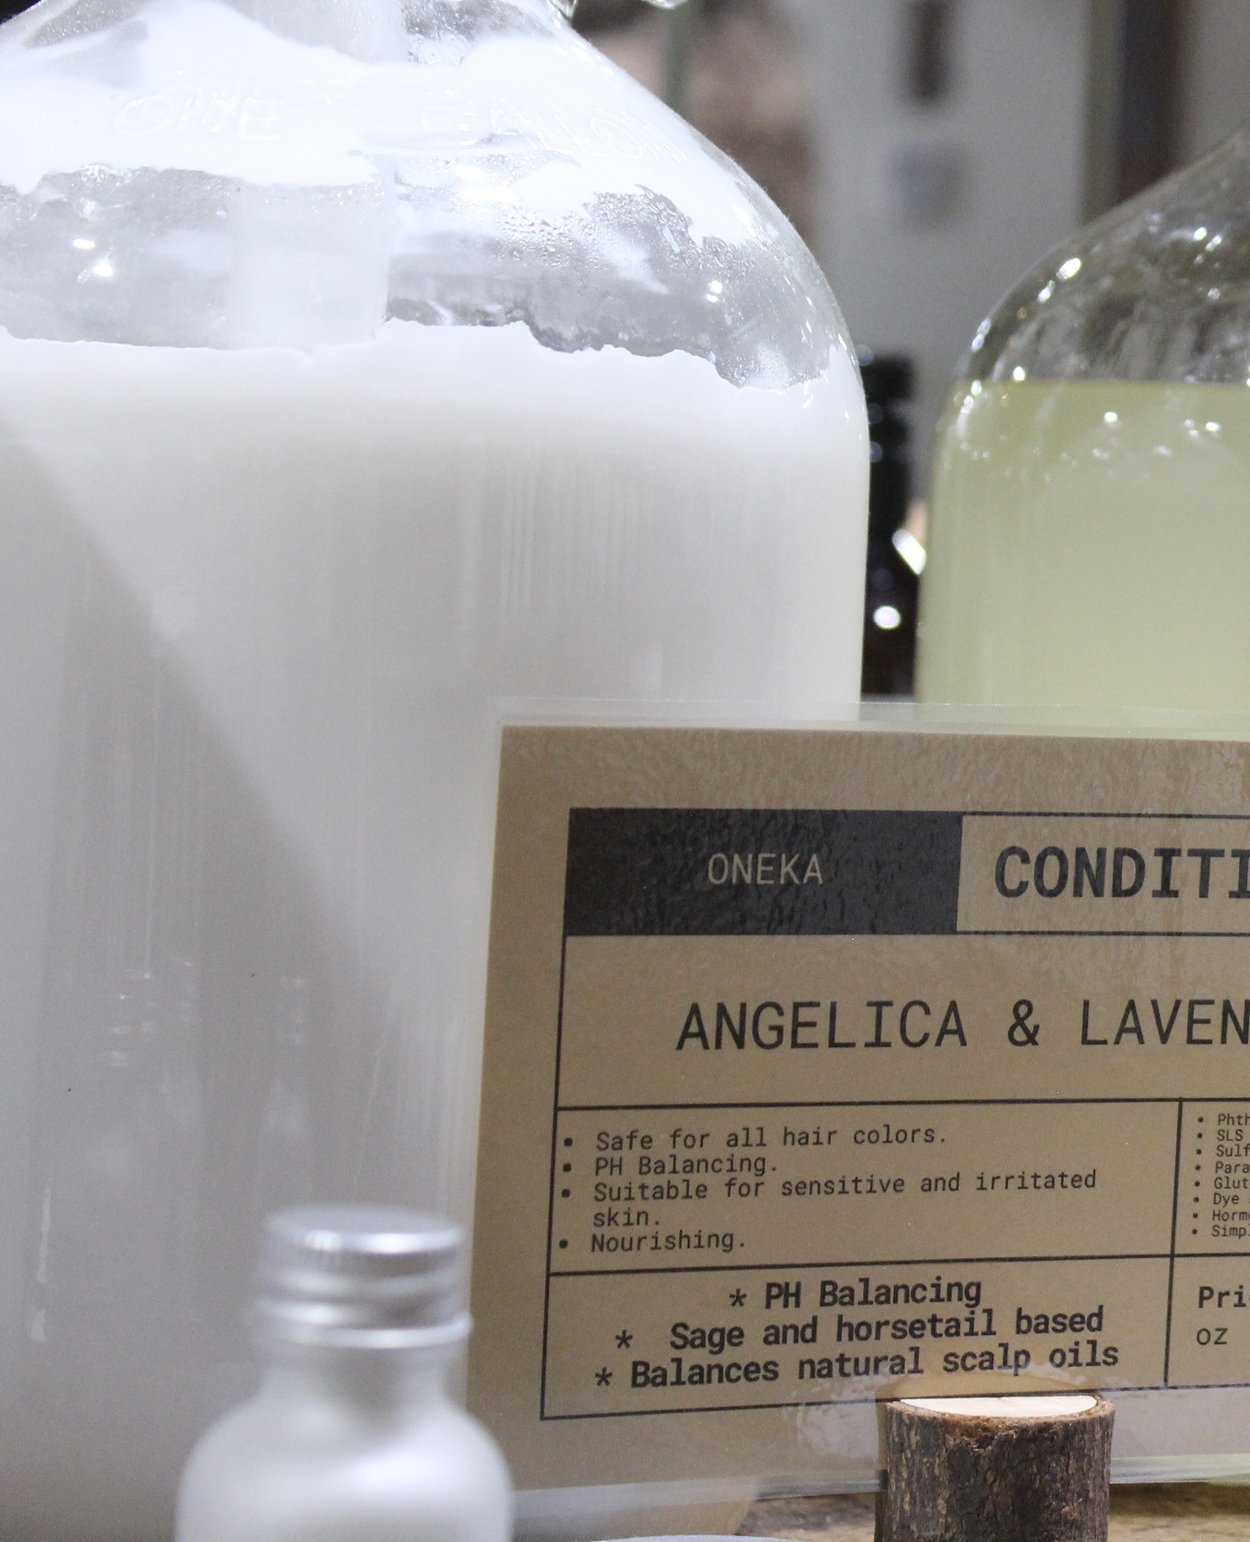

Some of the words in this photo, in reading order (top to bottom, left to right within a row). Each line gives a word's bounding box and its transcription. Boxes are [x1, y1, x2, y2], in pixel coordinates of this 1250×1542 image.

[708, 852, 823, 885] ONEKA
[675, 1000, 967, 1051] ANGELICA
[1007, 998, 1040, 1047] &
[596, 1129, 653, 1152] Safe
[669, 1128, 710, 1149] for
[726, 1126, 767, 1148] all
[782, 1126, 838, 1146] hair
[853, 1123, 945, 1145] colors.
[1217, 1128, 1244, 1142] SLS
[595, 1156, 623, 1177] PH
[638, 1153, 777, 1178] Balancing.
[593, 1178, 708, 1203] Suitable
[724, 1176, 765, 1198] for
[781, 1176, 905, 1197] sensitive
[920, 1171, 961, 1193] and
[976, 1168, 1097, 1191] irritated
[1212, 1191, 1240, 1208] Dye
[593, 1206, 660, 1228] skin.
[590, 1229, 745, 1254] Nourishing.
[765, 1281, 802, 1310] PH
[819, 1275, 982, 1309] Balancing
[669, 1321, 745, 1356] Sage
[762, 1315, 818, 1346] and
[836, 1307, 997, 1343] horsetail
[1015, 1304, 1104, 1335] based
[1196, 1327, 1228, 1346] oz
[631, 1357, 779, 1389] Balances
[798, 1346, 924, 1380] natural
[942, 1342, 1031, 1377] scalp
[1048, 1339, 1119, 1368] oils
